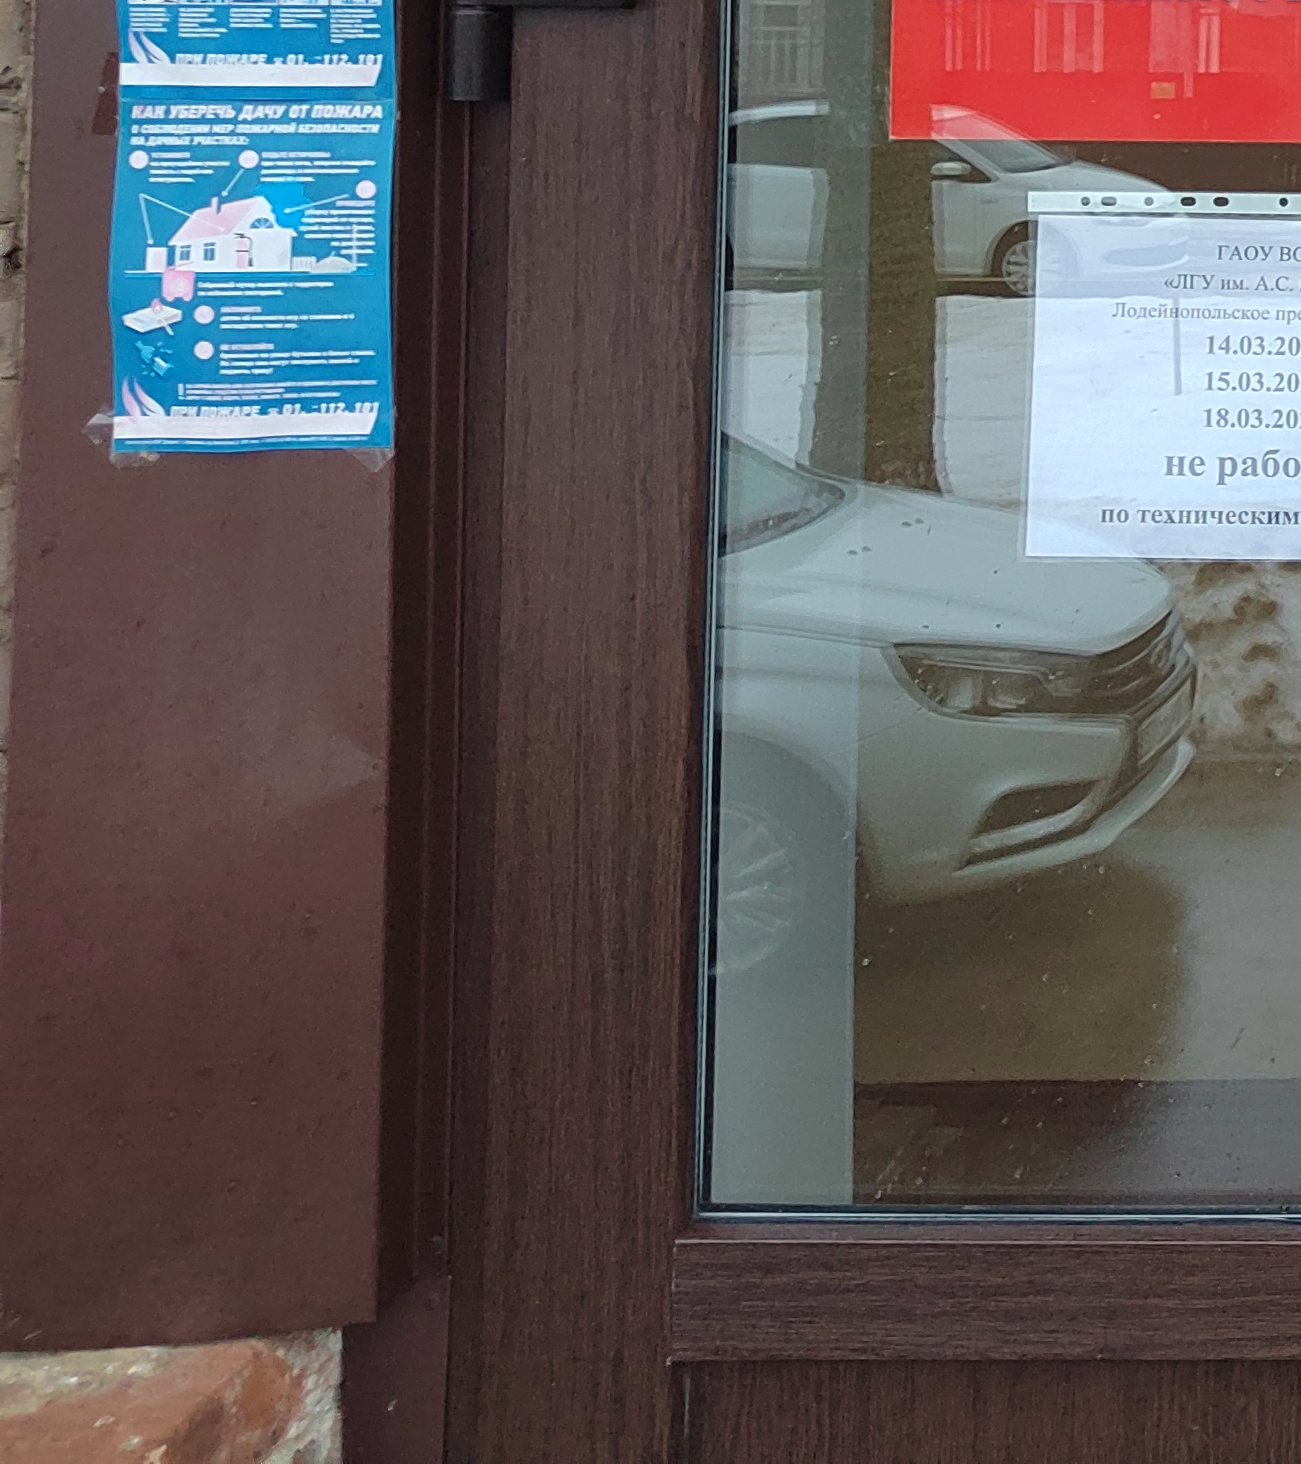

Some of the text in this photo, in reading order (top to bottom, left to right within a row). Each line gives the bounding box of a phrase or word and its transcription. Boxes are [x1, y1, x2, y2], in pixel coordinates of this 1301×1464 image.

[131, 104, 383, 121] КАК УБЕРЕЧЬ ДАЧУ ОТ ПОЖАРА
[1216, 244, 1275, 263] ГАОУ
[1163, 273, 1215, 290] «ЛГУ
[1221, 278, 1249, 292] им.
[1254, 275, 1295, 293] А.С.
[1111, 302, 1270, 323] Лодейнопольское
[1163, 453, 1206, 477] не
[1100, 507, 1130, 525] по
[1137, 506, 1300, 527] техническим
